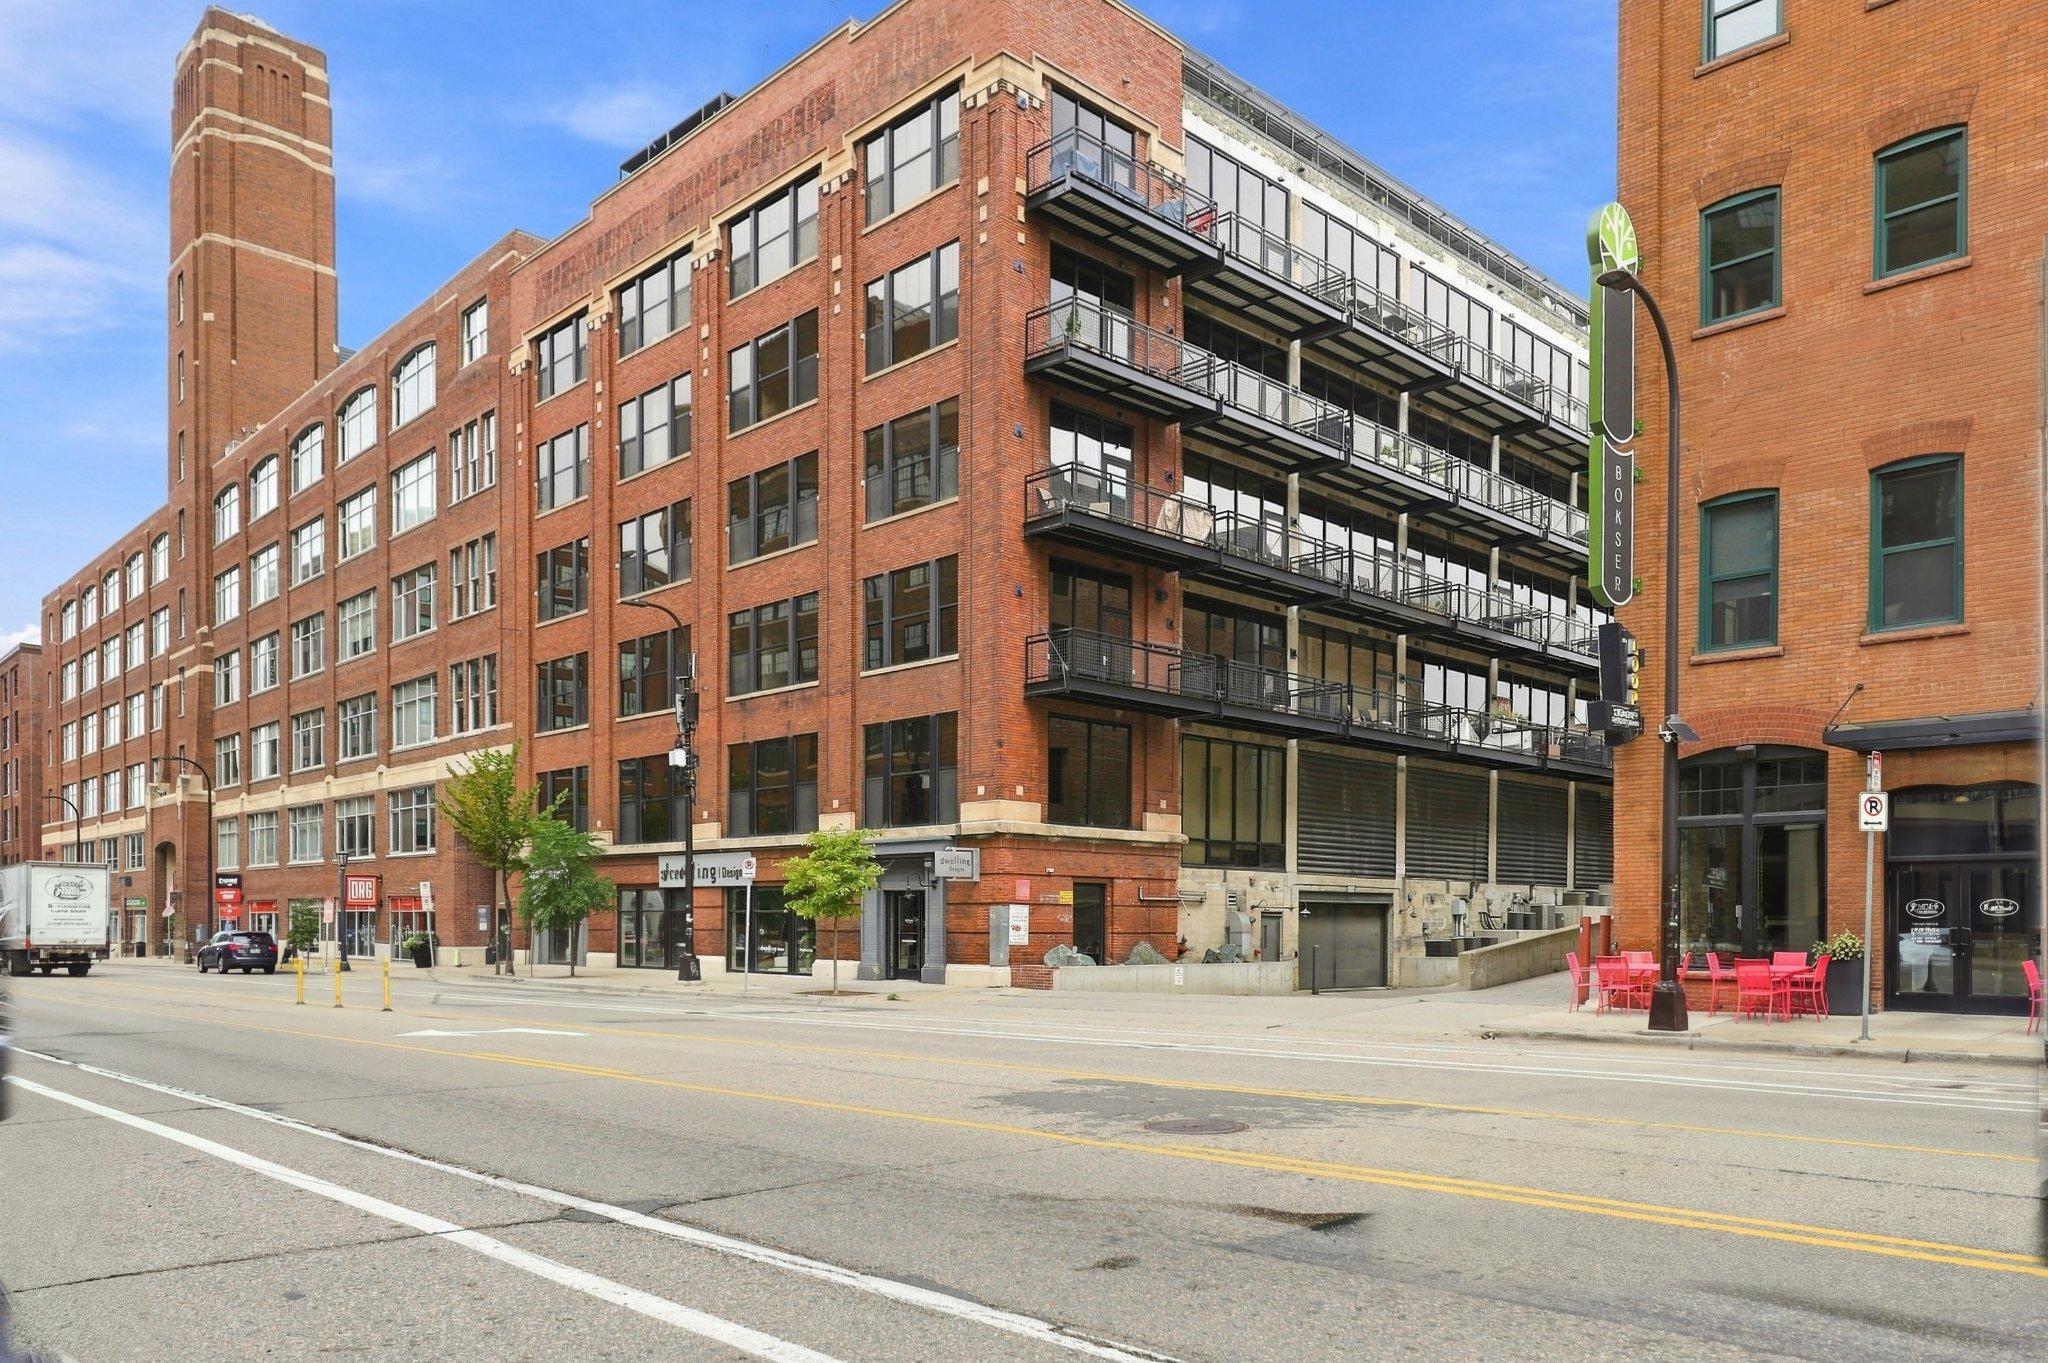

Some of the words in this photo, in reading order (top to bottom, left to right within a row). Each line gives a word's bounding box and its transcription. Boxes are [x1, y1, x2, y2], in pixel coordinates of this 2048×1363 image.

[1614, 465, 1623, 592] BOKSER
[940, 856, 971, 866] dwelling
[351, 881, 373, 899] DRG
